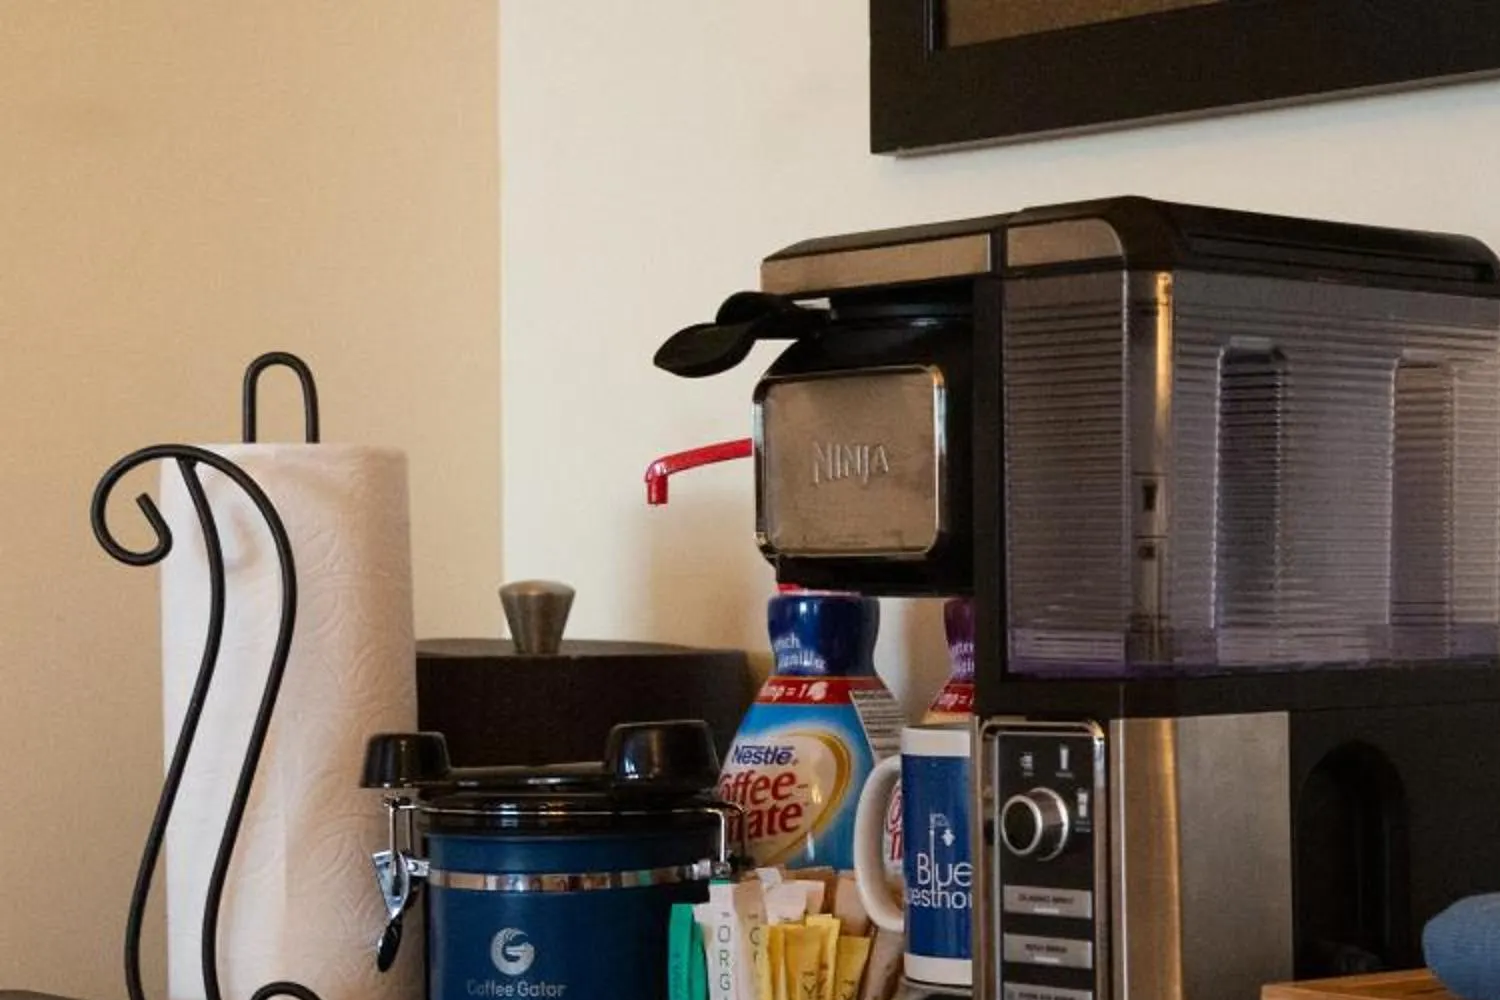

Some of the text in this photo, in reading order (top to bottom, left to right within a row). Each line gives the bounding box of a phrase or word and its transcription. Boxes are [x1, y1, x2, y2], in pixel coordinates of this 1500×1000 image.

[811, 440, 889, 487] NINJA
[466, 978, 568, 998] Coffee Gator
